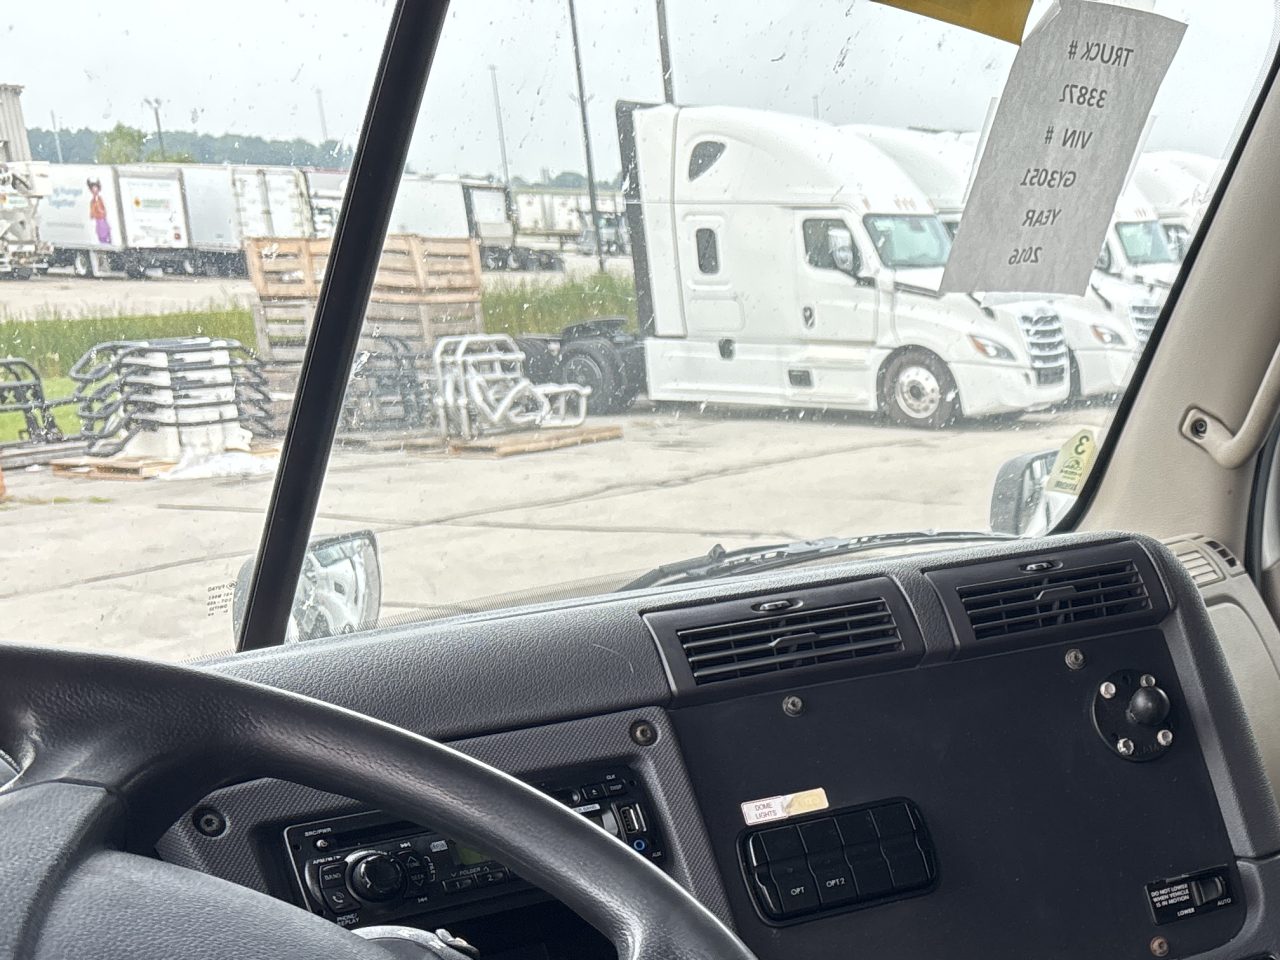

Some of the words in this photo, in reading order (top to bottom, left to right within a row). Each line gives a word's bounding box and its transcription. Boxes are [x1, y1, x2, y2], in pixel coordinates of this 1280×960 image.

[754, 802, 774, 811] DOME
[755, 809, 778, 820] LIGHTS
[459, 867, 481, 876] FOLDER
[790, 885, 805, 896] OPT
[1160, 887, 1171, 895] NOT
[1171, 883, 1188, 892] LOWER
[1168, 895, 1190, 905] MOTION
[1217, 897, 1232, 906] AUTO
[1176, 907, 1196, 917] LOWER
